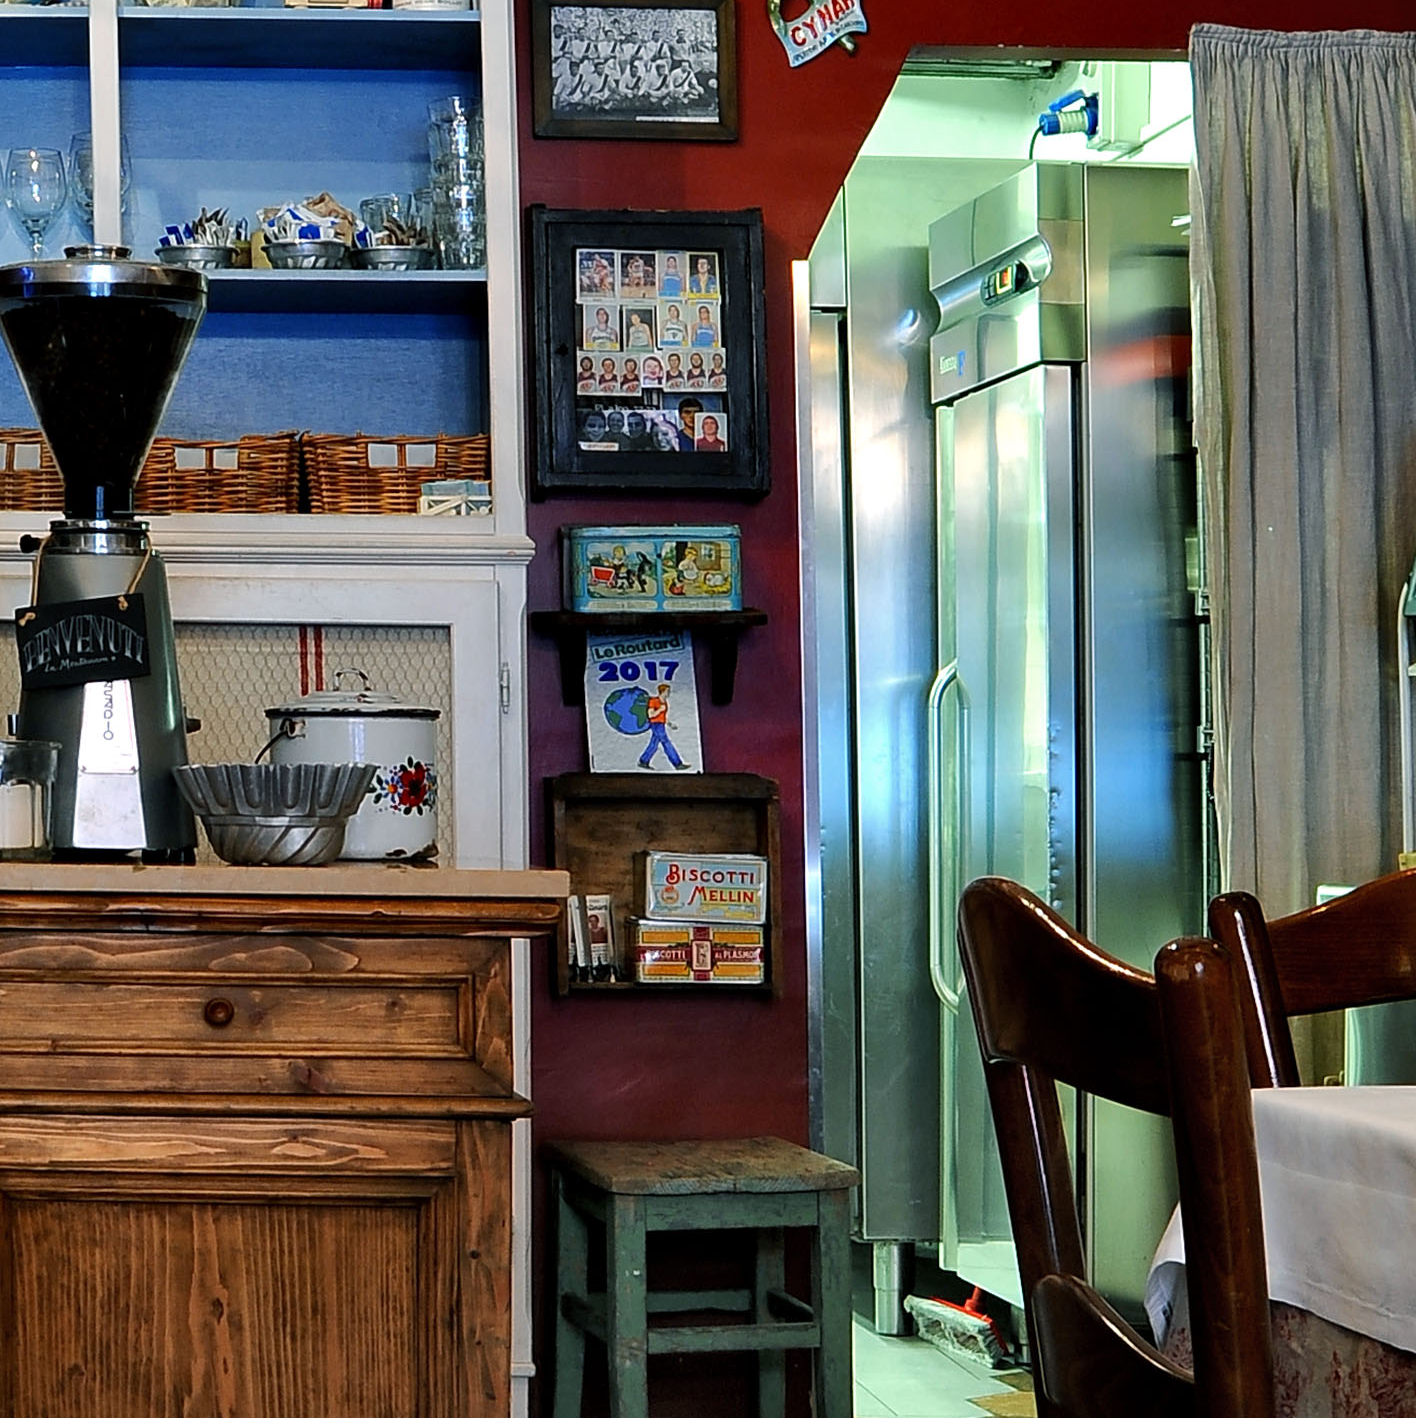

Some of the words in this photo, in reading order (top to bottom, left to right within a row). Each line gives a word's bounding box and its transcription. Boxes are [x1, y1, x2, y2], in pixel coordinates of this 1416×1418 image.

[23, 614, 144, 673] BENVENUTI
[599, 661, 679, 682] 2017
[665, 863, 755, 885] BISCOTTI
[687, 885, 755, 905] MELLIN
